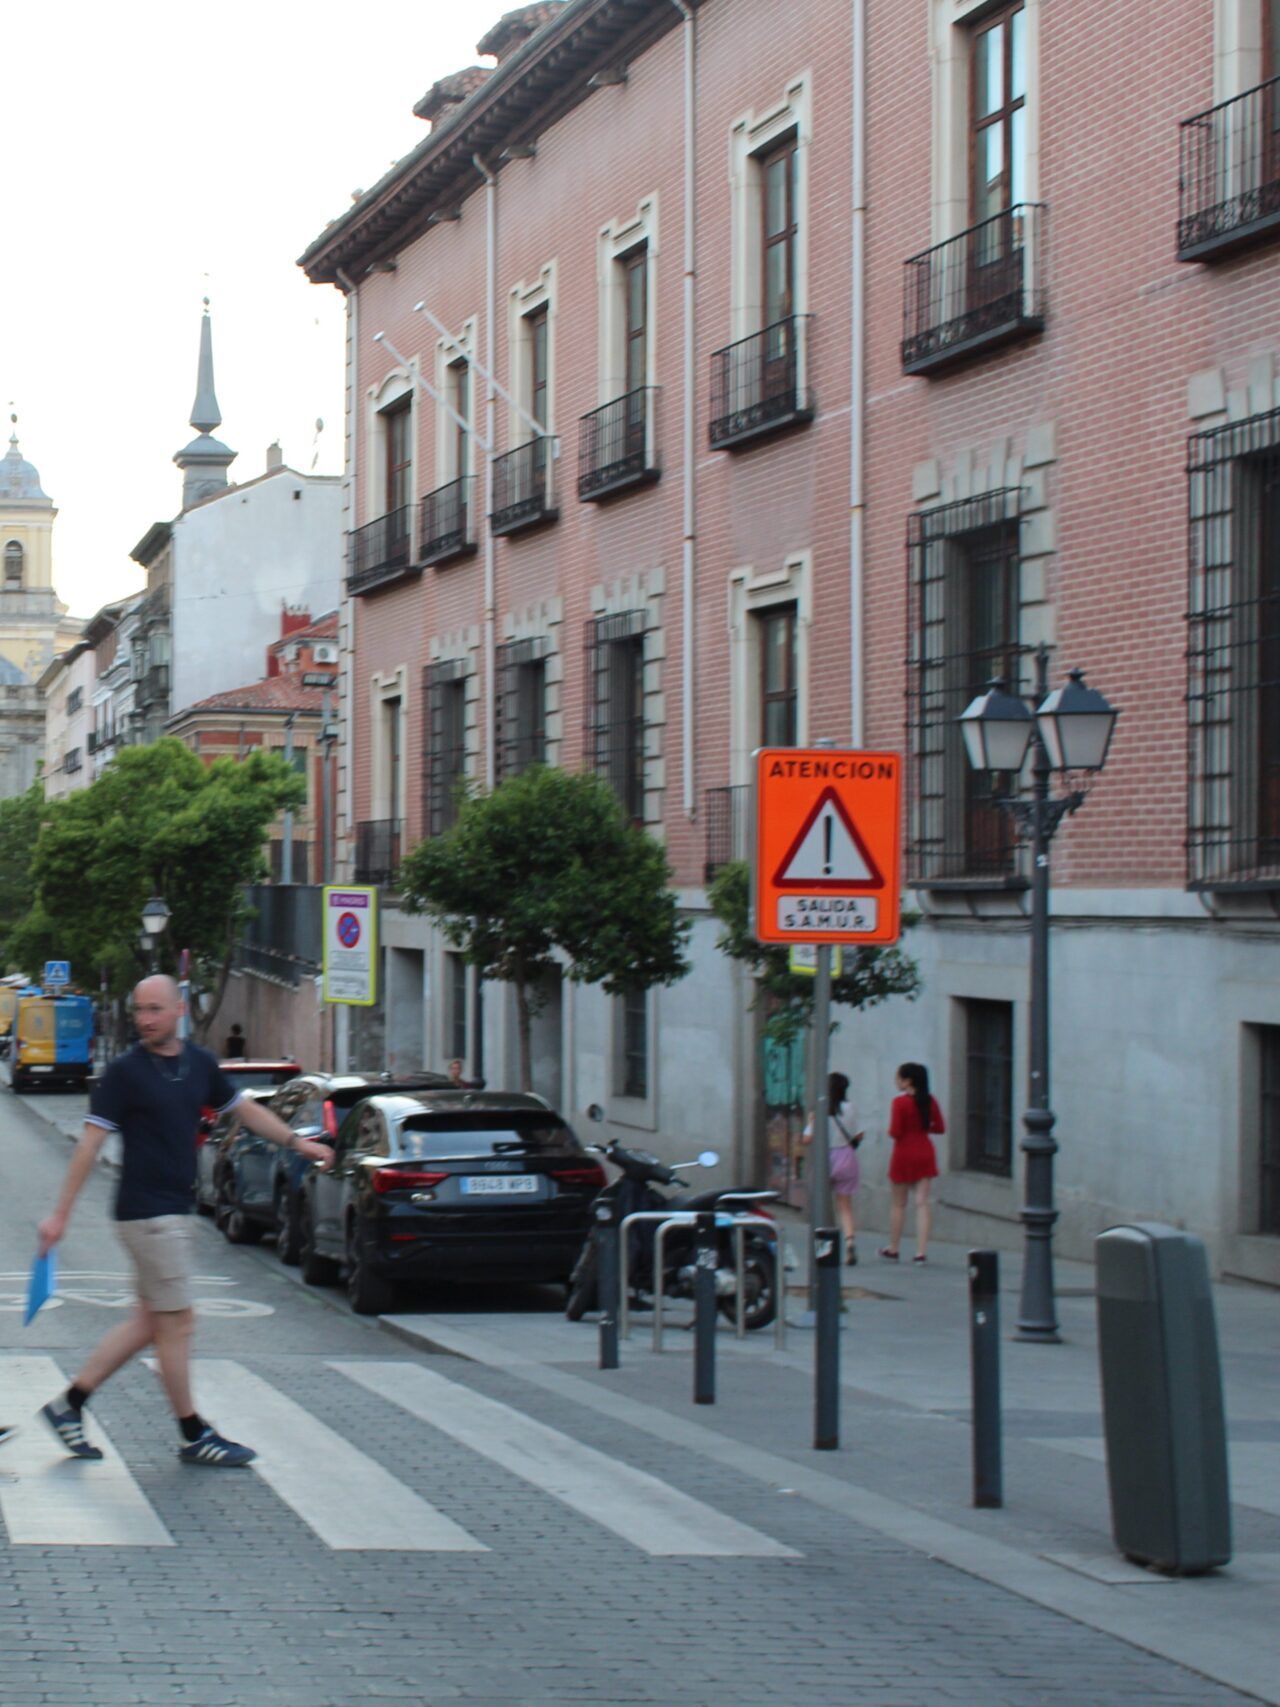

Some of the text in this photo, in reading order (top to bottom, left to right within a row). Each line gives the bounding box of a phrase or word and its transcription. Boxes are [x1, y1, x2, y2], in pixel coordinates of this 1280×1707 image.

[769, 761, 893, 780] ATENCION
[796, 899, 858, 913] SALIDA
[784, 914, 871, 929] S.A.M.U.R.
